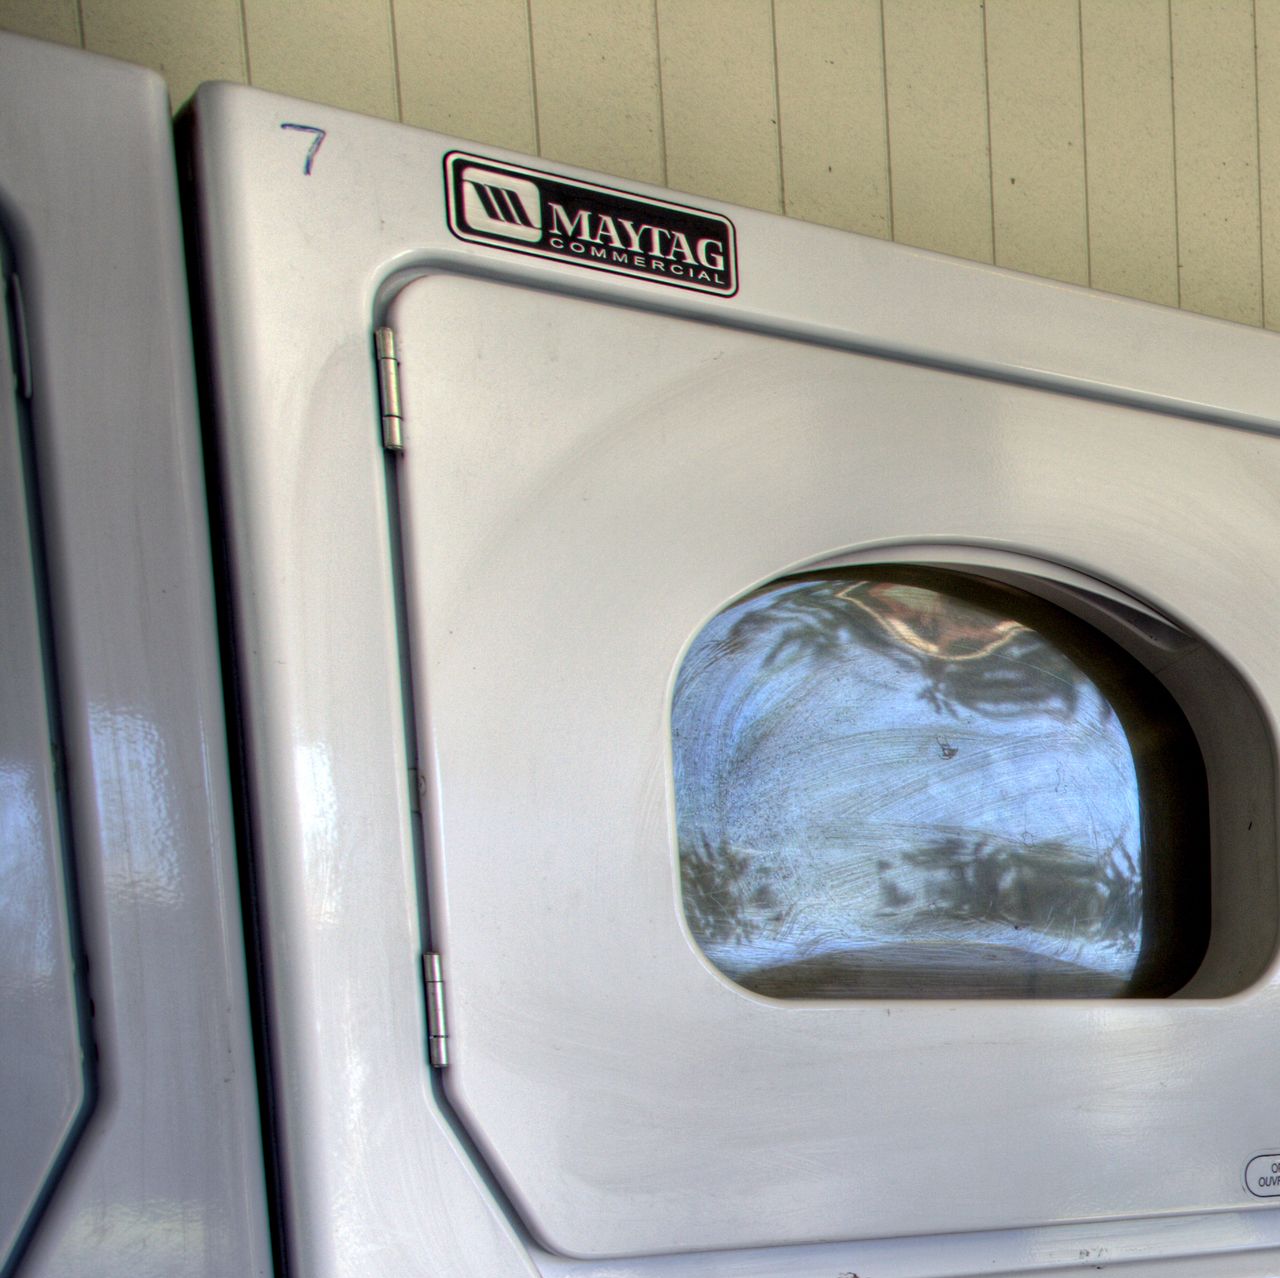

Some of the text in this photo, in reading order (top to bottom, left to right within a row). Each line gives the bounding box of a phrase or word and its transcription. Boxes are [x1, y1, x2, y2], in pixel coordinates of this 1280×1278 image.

[280, 122, 327, 176] 7
[548, 202, 725, 271] MAYTAG
[550, 237, 726, 285] COMMERCIAL
